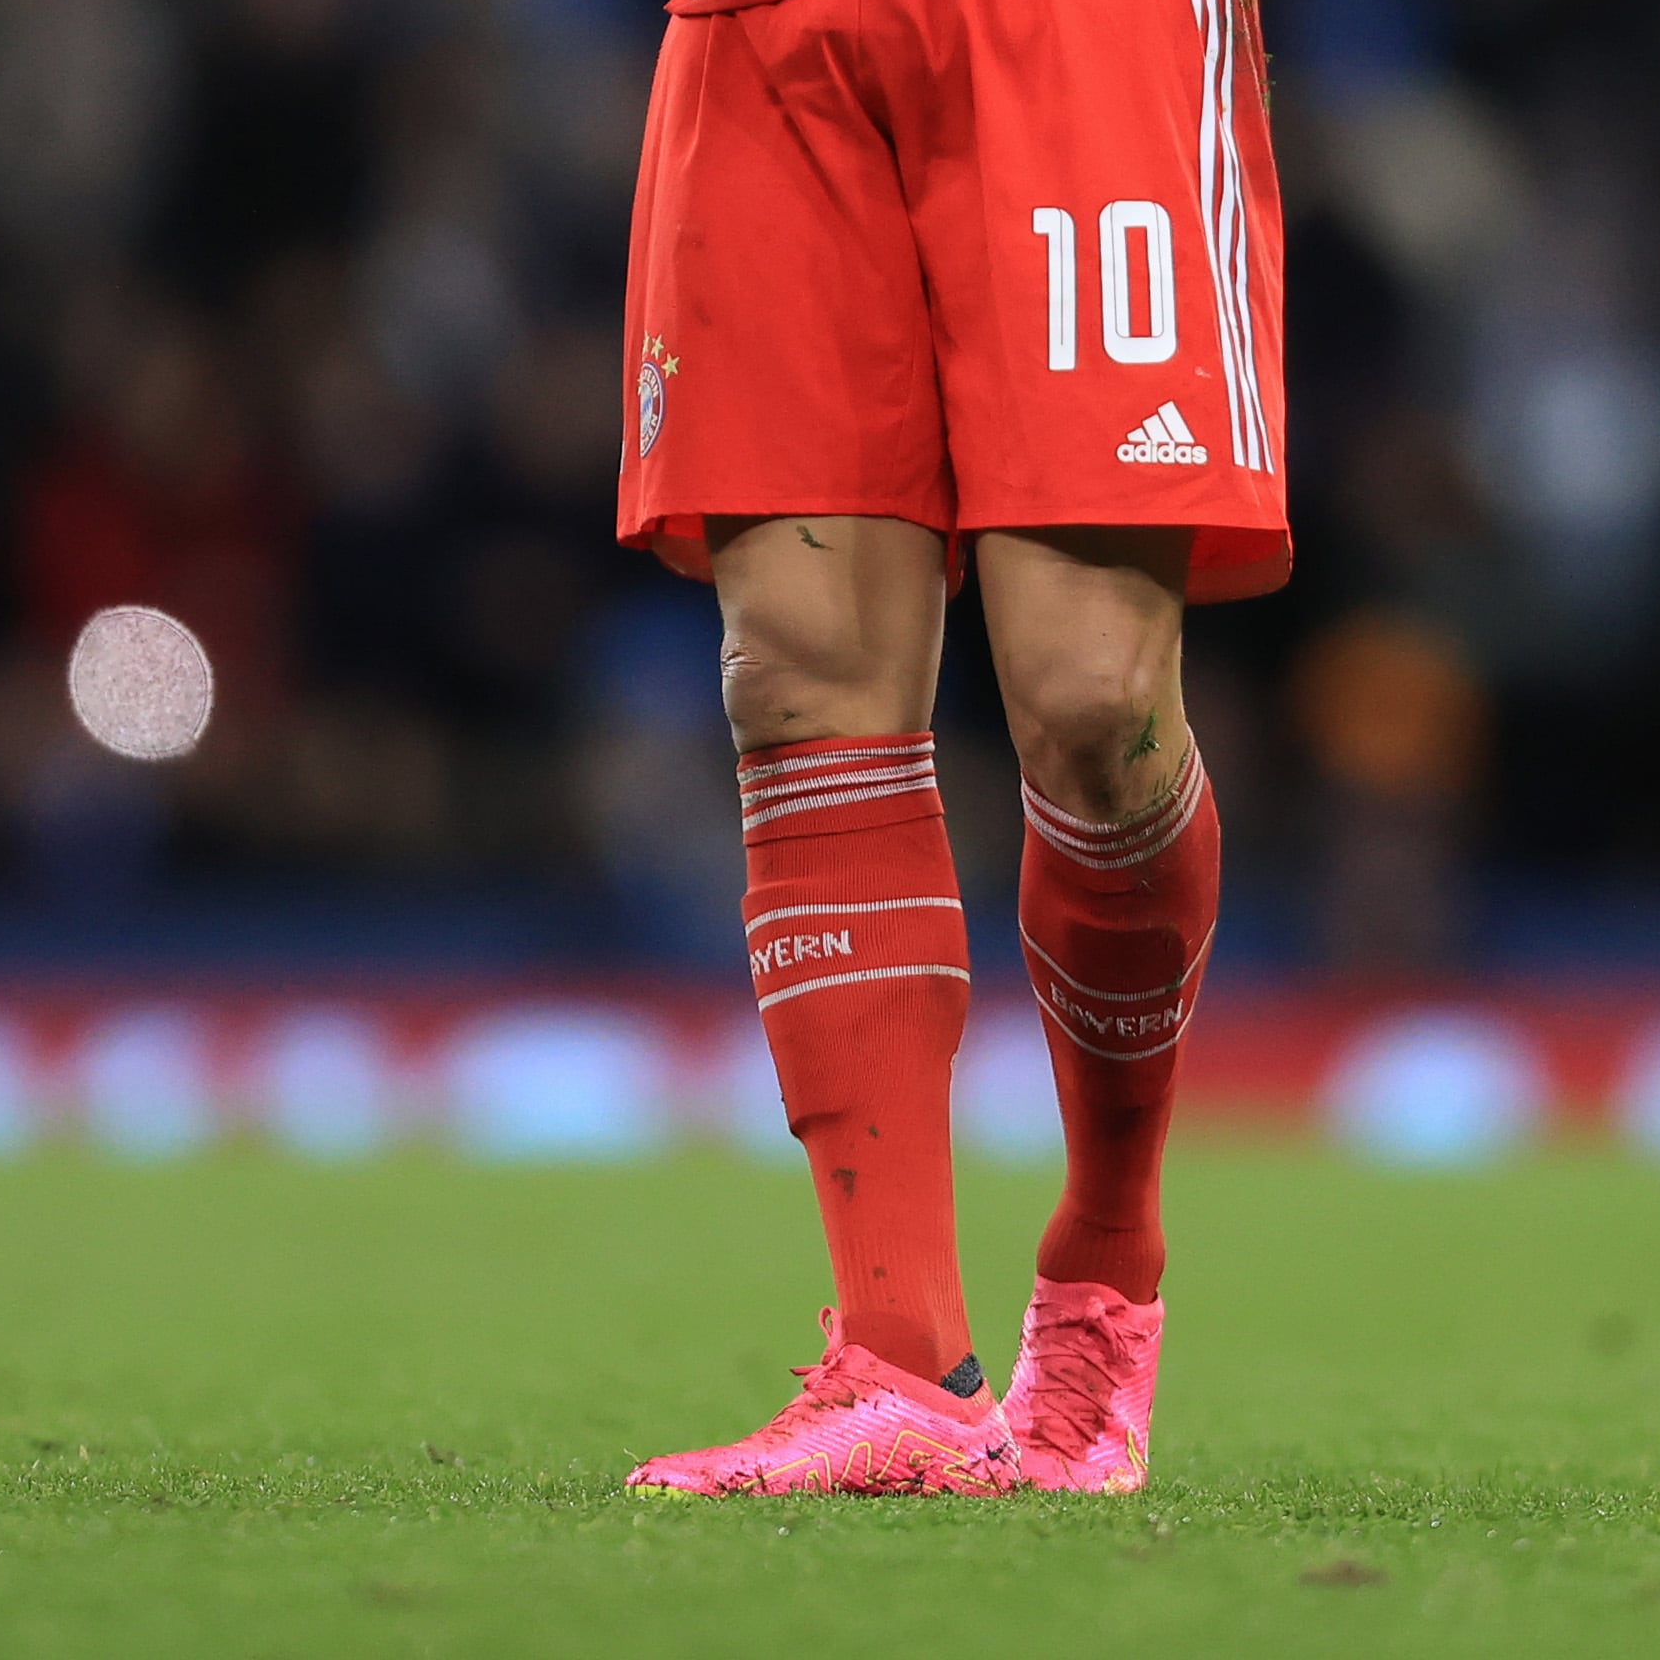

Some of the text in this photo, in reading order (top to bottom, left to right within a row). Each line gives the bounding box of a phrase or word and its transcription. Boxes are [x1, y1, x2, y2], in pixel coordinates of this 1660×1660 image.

[1032, 200, 1179, 371] 10
[1116, 439, 1208, 466] adidas
[1050, 981, 1184, 1037] BAYERN
